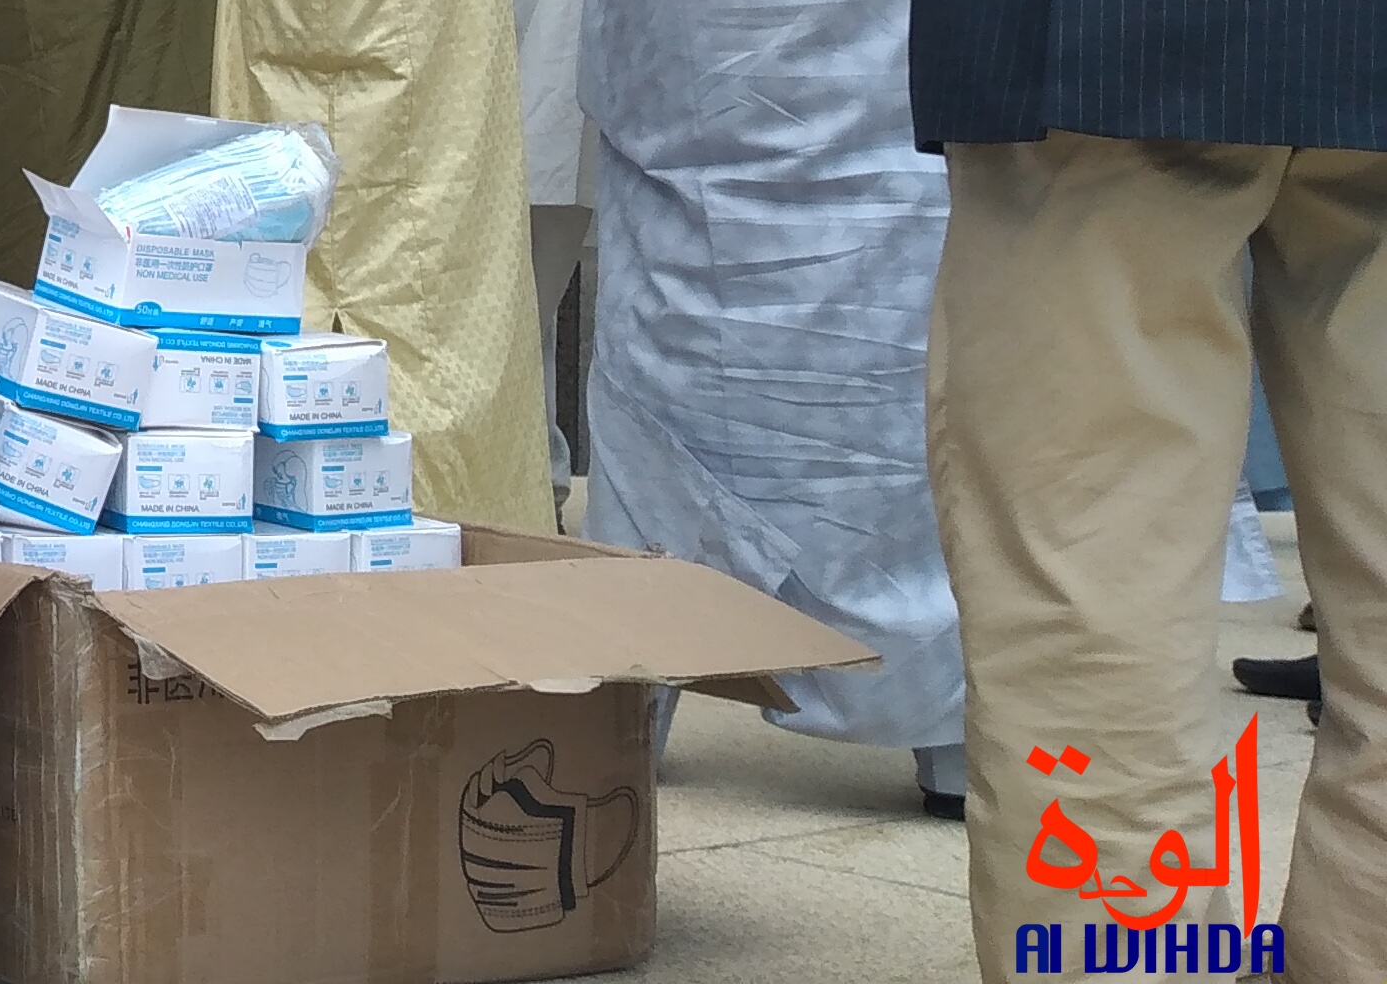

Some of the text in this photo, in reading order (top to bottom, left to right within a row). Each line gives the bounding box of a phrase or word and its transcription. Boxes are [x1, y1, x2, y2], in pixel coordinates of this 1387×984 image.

[137, 245, 215, 257] DISPOSABLE MASK
[136, 269, 209, 282] NON MEDICAL USE
[201, 356, 222, 364] CHINA
[35, 377, 91, 397] MADE IN CHINA
[290, 413, 310, 421] MADE
[321, 412, 342, 420] CHINA
[17, 479, 25, 488] IN
[26, 482, 49, 497] CHINA
